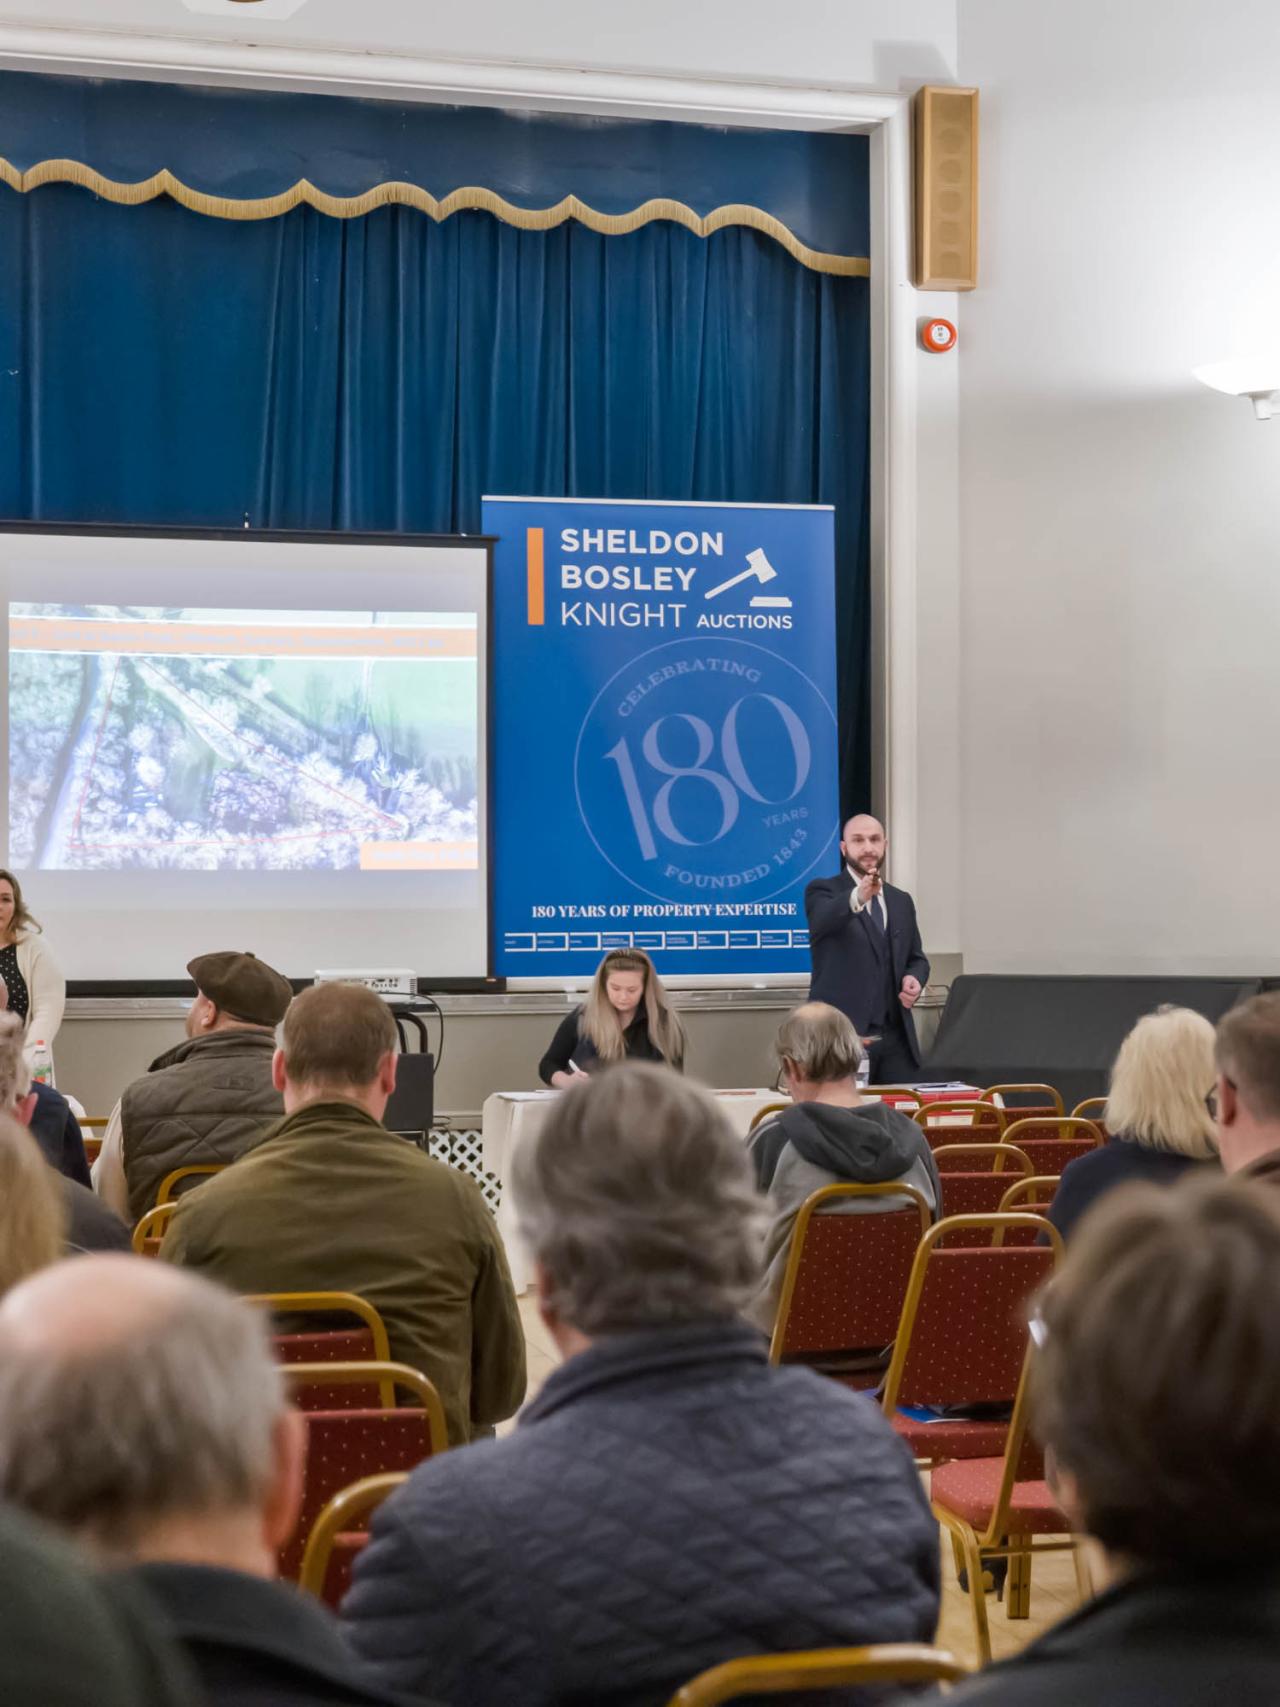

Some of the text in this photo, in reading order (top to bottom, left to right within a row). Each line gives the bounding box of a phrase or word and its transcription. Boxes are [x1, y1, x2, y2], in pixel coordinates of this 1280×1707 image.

[561, 528, 723, 556] SHELDON
[561, 565, 696, 591] BOSLEY
[561, 602, 687, 627] KNIGHT
[696, 614, 793, 629] AUCTIONS
[617, 658, 762, 717] CELEBRATING
[604, 692, 811, 861] 180
[762, 807, 809, 828] YEARS
[664, 828, 808, 889] FOUNDED 1843
[532, 903, 797, 918] 180 YEARS OF PROPERTY EXPERTISE
